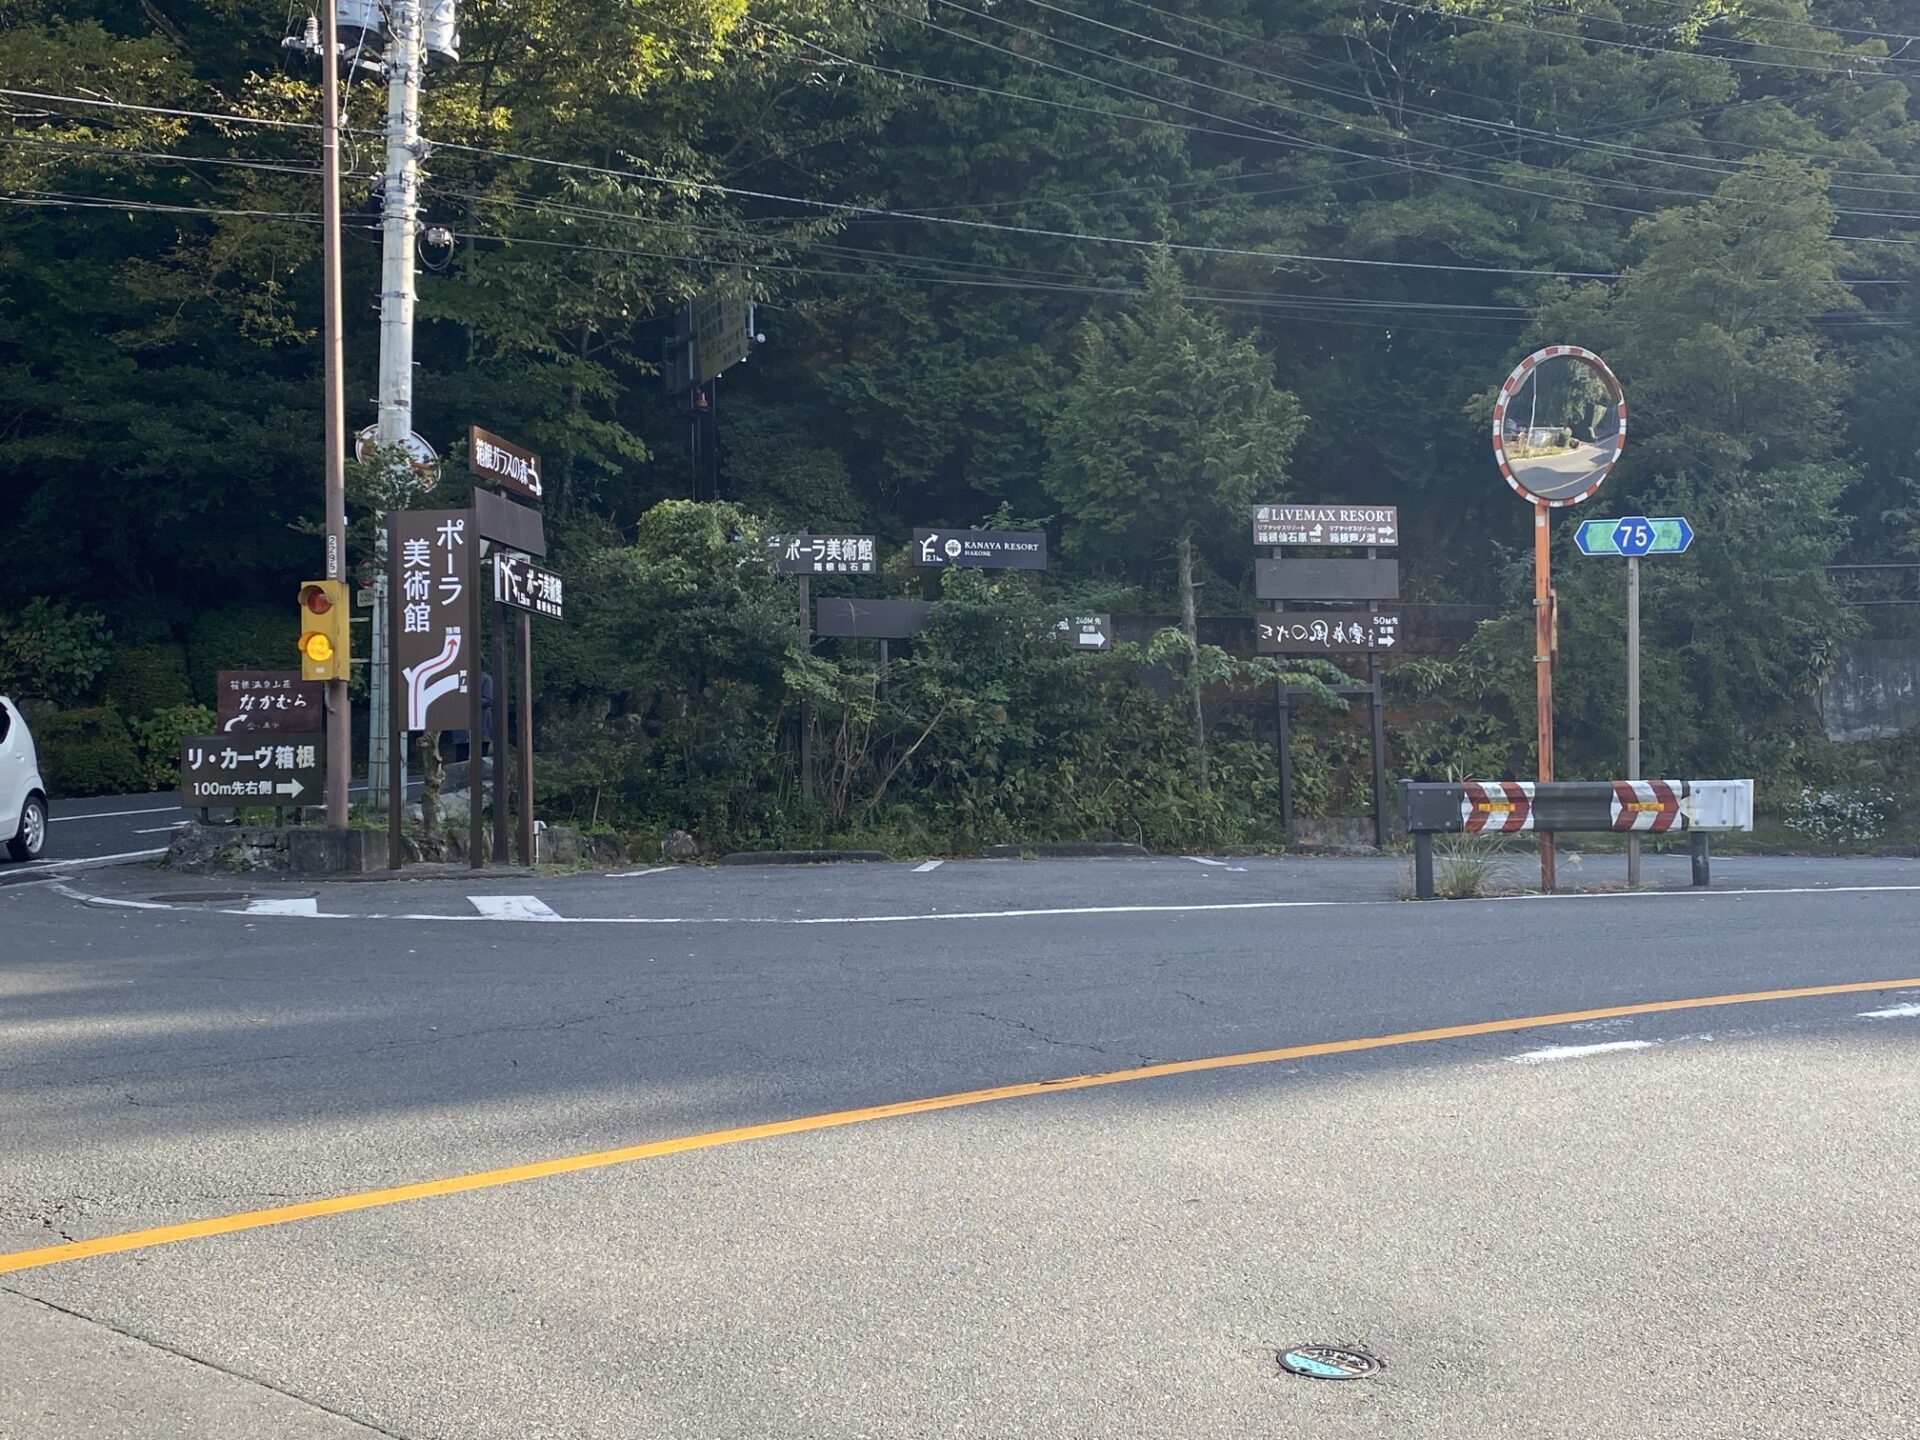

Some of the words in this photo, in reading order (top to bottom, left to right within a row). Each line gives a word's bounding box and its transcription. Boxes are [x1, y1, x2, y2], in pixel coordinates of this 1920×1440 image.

[475, 438, 528, 485] 箱根ガラスの森
[1271, 509, 1336, 521] LiVEMAX
[1340, 510, 1394, 522] RESORT
[964, 541, 1001, 550] KANAYA
[1004, 543, 1039, 551] RESORT
[1620, 526, 1647, 547] 75
[785, 539, 873, 561] ポーラ美術館
[437, 519, 464, 606] ポーラ
[403, 538, 431, 633] 美術館
[239, 694, 306, 711] なかむら
[188, 745, 315, 770] リ・カーヴ箱根
[193, 781, 272, 796] 100m先右側
